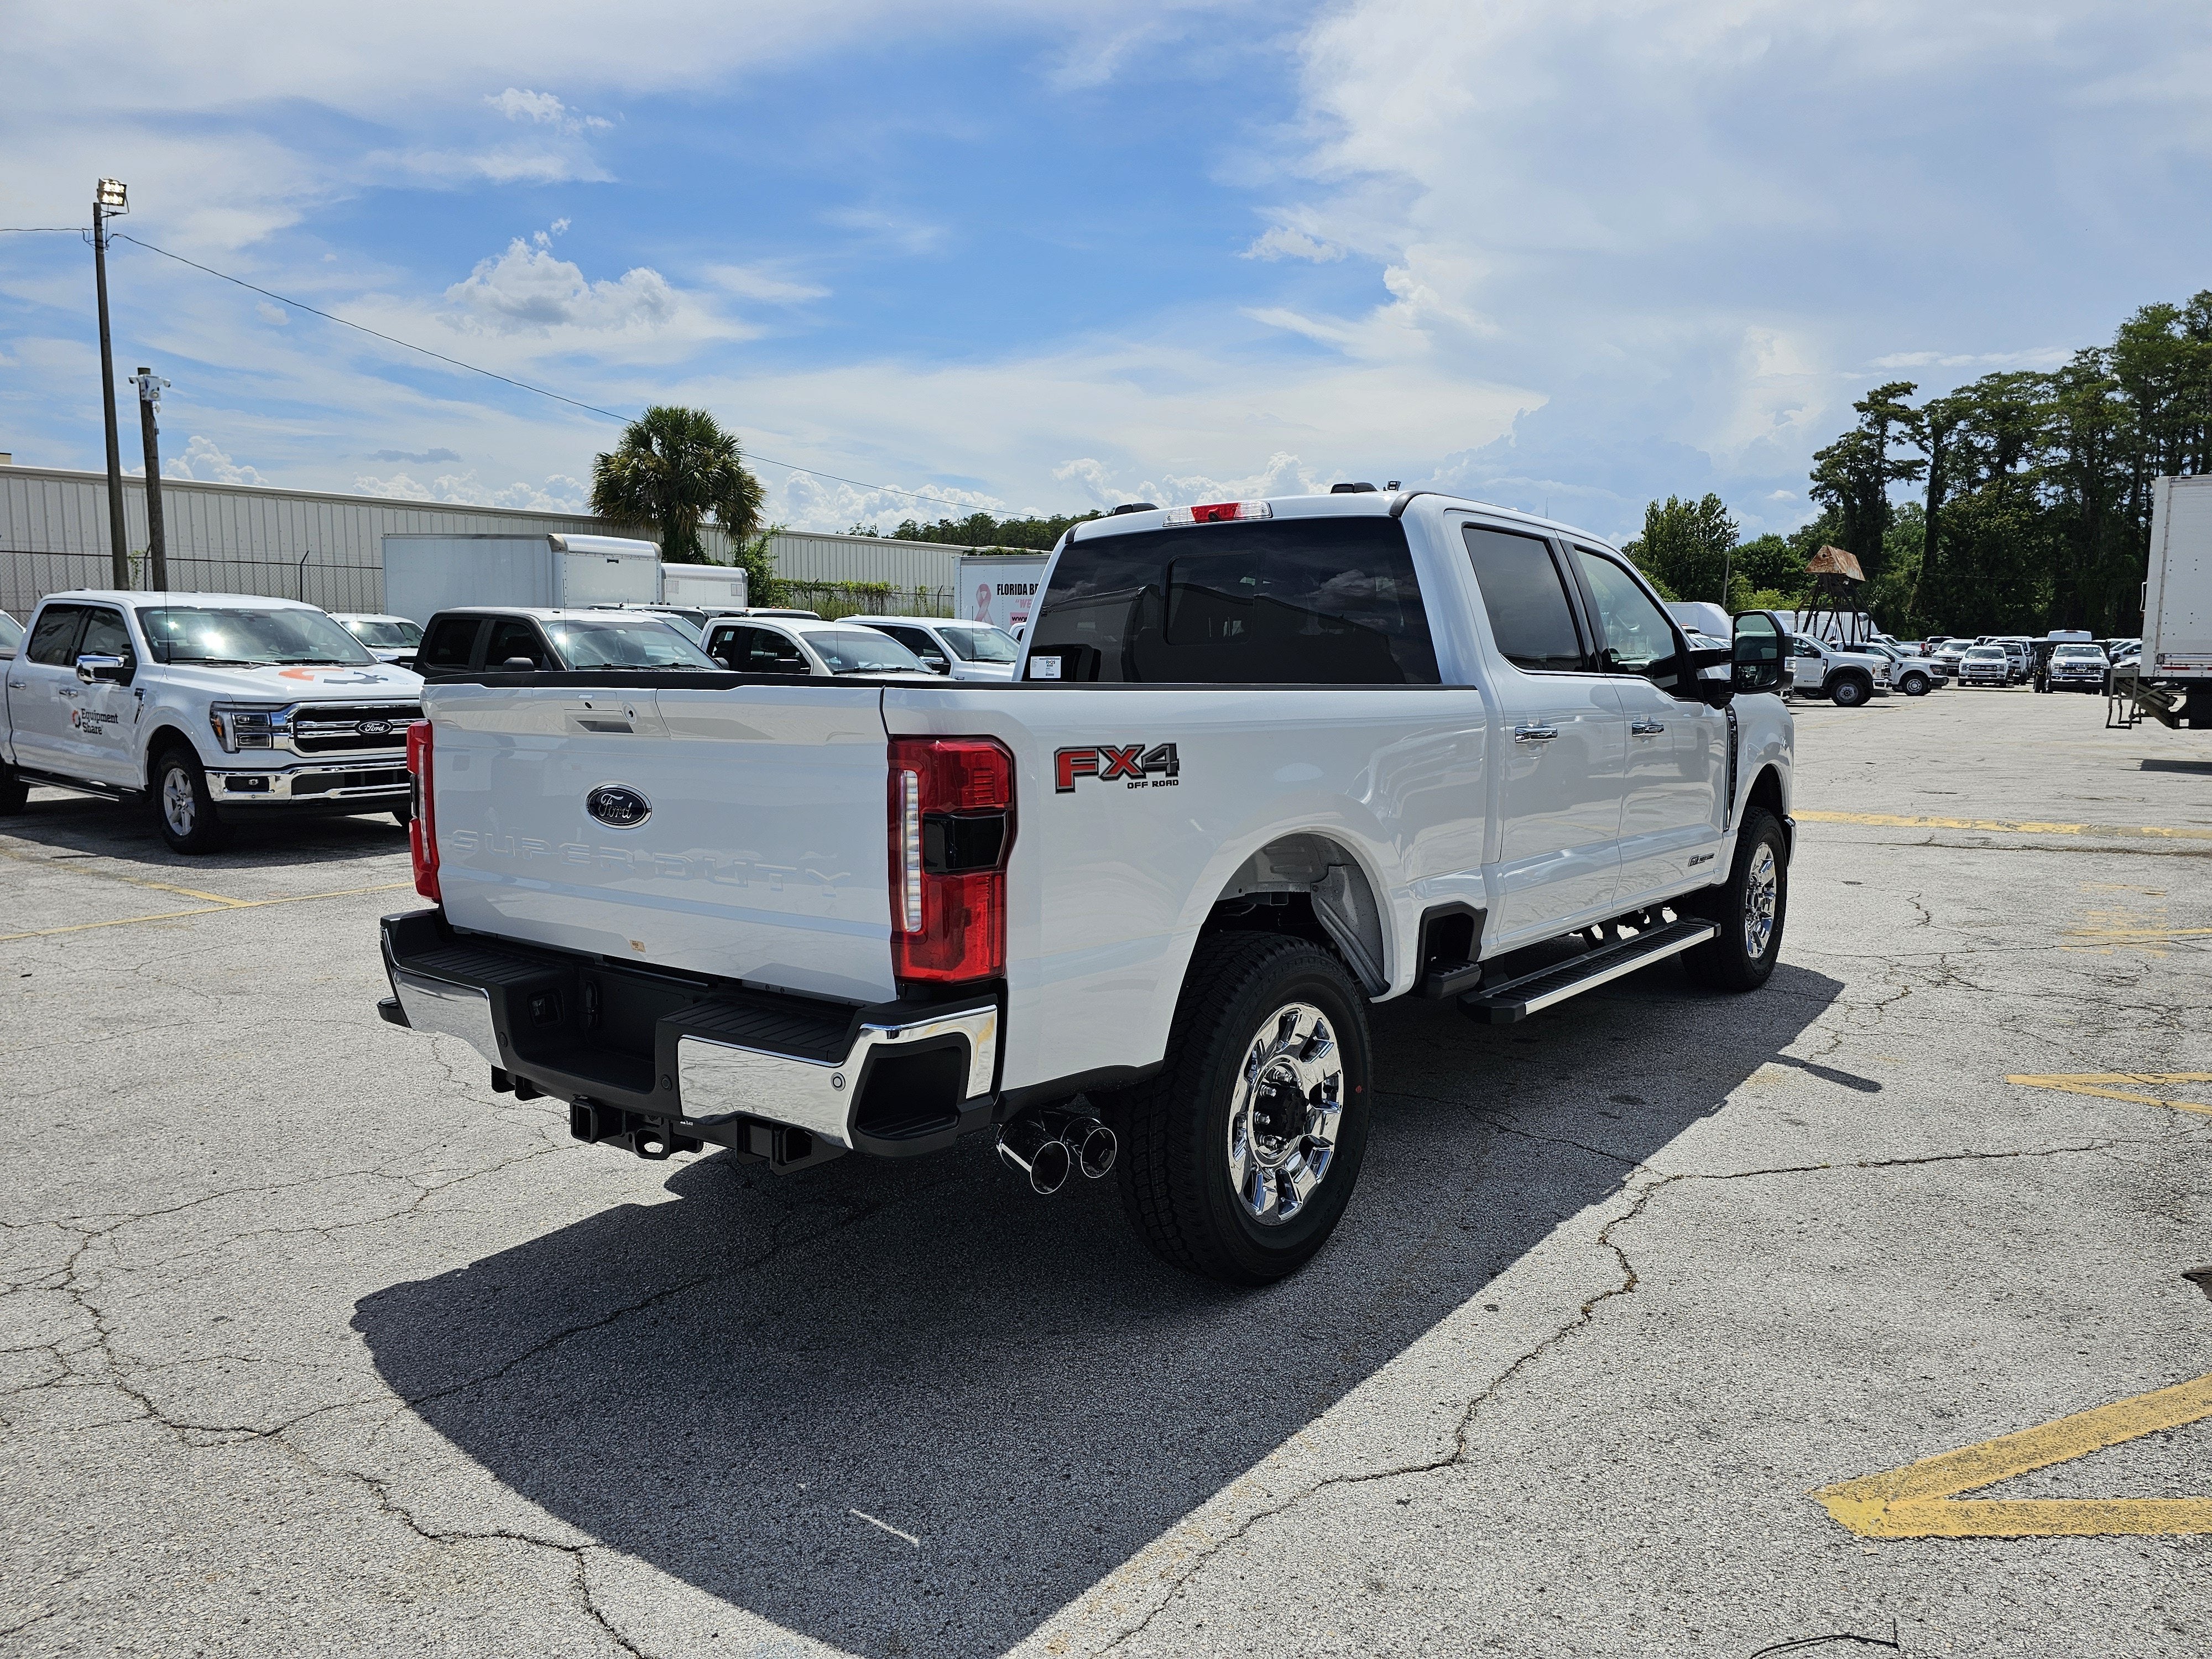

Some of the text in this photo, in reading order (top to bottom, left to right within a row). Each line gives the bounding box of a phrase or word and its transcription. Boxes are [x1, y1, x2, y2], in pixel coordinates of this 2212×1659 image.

[997, 583, 1027, 595] FLORIDA
[81, 708, 118, 723] Equipment
[82, 722, 102, 734] Share
[364, 723, 385, 732] Ford
[1053, 743, 1180, 794] FX4
[1127, 779, 1179, 789] OFF ROAD
[598, 793, 633, 818] Ford
[452, 830, 851, 897] SUPER DUTY
